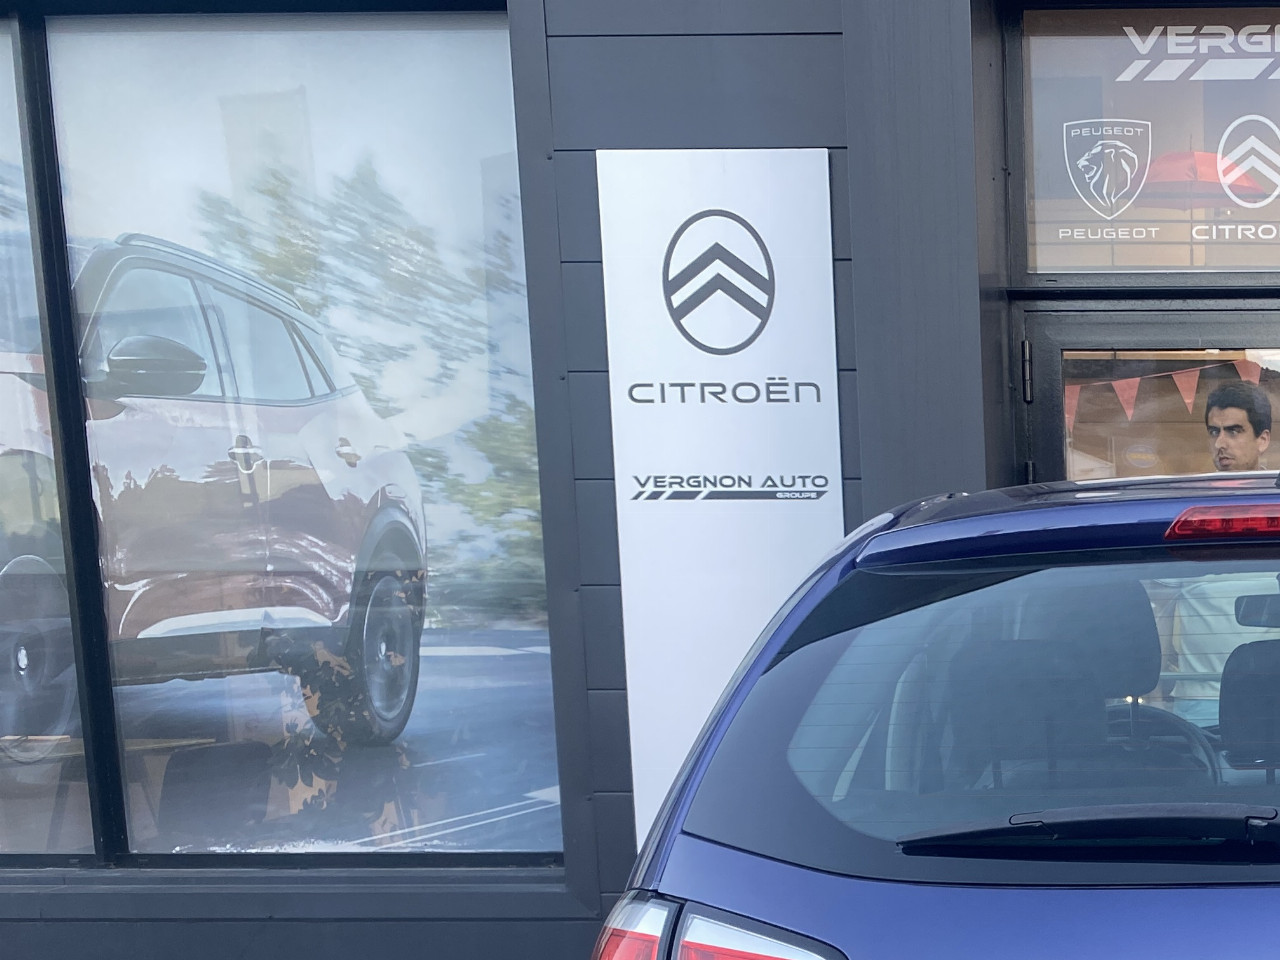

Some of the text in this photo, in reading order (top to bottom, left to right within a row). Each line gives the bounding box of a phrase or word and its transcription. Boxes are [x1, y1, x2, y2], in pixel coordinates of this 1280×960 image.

[1071, 127, 1144, 138] PEUGEOT
[1058, 228, 1160, 239] PEUGEOT
[627, 377, 821, 403] CITROËN
[631, 475, 829, 489] VERGNON AUTO
[775, 491, 818, 499] GROUPE
